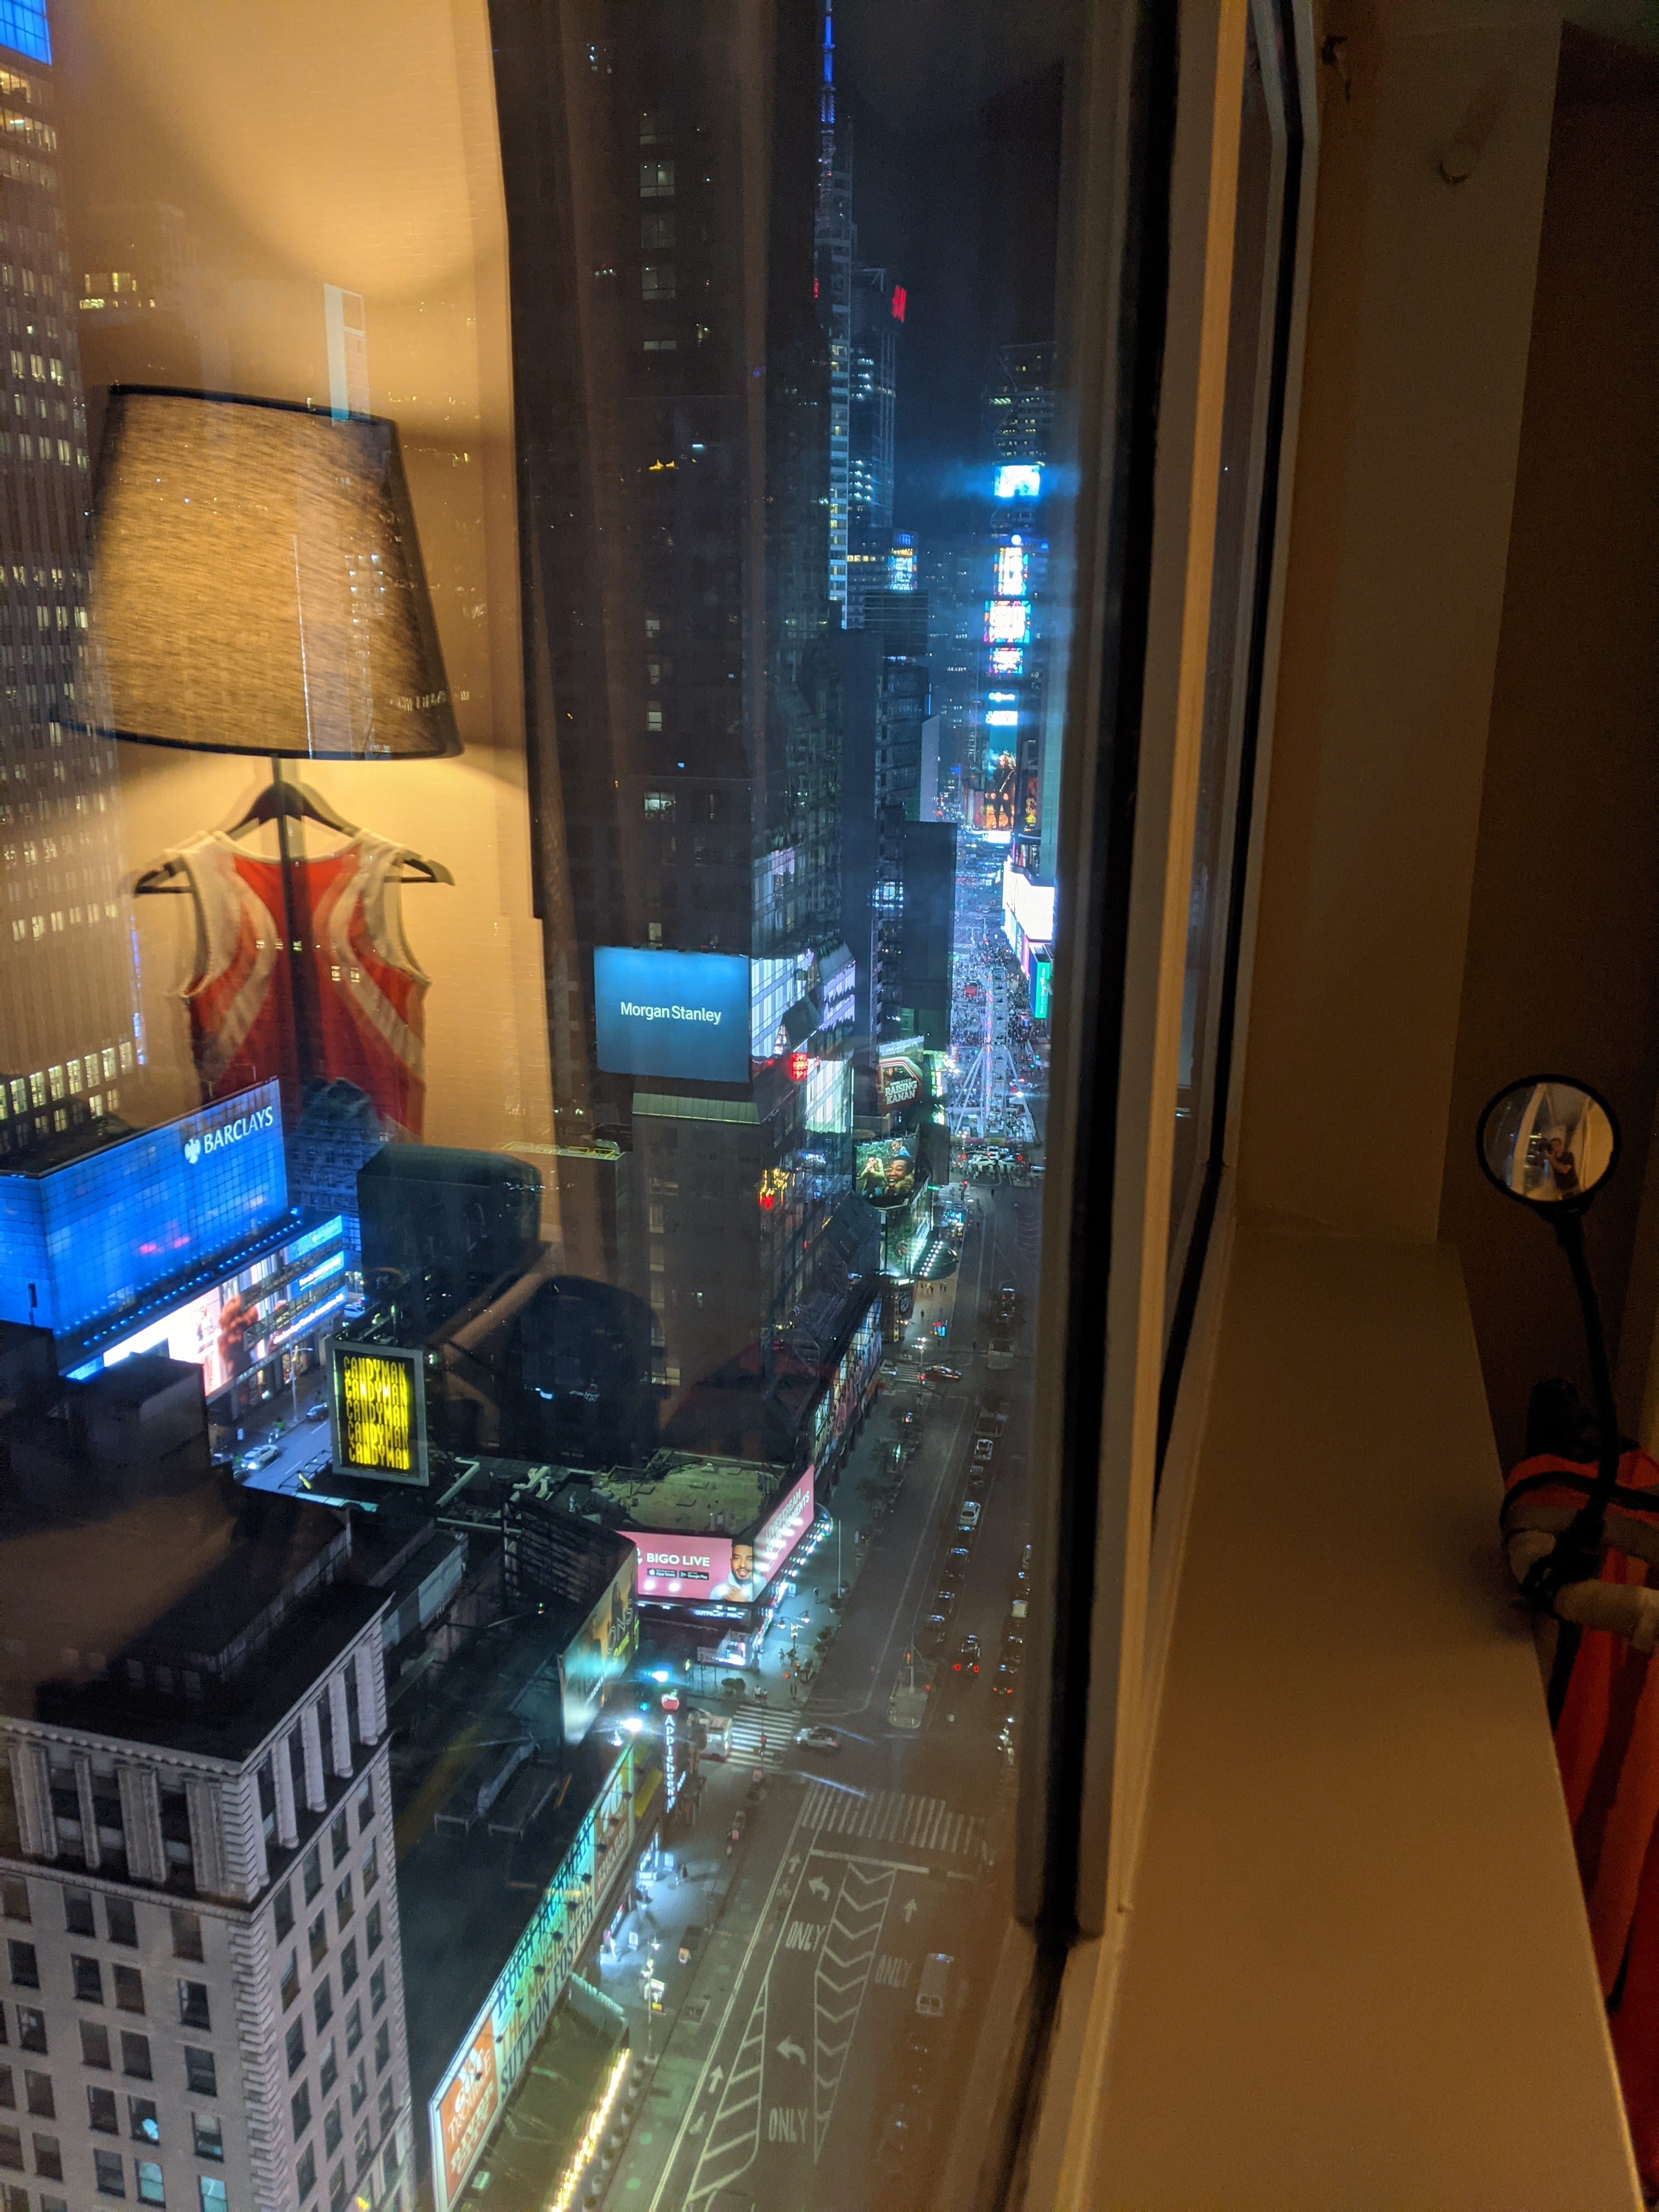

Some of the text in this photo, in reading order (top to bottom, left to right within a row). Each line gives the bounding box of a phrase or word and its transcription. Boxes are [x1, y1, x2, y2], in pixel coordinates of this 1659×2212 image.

[620, 1001, 721, 1025] Morgan Stanley
[885, 1080, 917, 1097] RAISING
[886, 1089, 916, 1104] KANAN
[204, 1106, 273, 1154] BARCLAYS
[343, 1356, 406, 1384] CANDYMAN
[345, 1377, 408, 1406] CANDYMAN
[346, 1399, 408, 1428] CANDYMAN
[348, 1420, 408, 1449] CANDYMAN
[348, 1441, 409, 1470] CANDYMAN
[647, 1553, 710, 1567] BIGO LIVE
[785, 1920, 826, 1951] ONLY
[497, 1923, 534, 2020] HUGH
[875, 1954, 914, 1988] ONLY
[501, 1979, 549, 2103] SUTTON
[554, 1894, 593, 1994] FOSTER
[769, 2106, 808, 2144] ONLY
